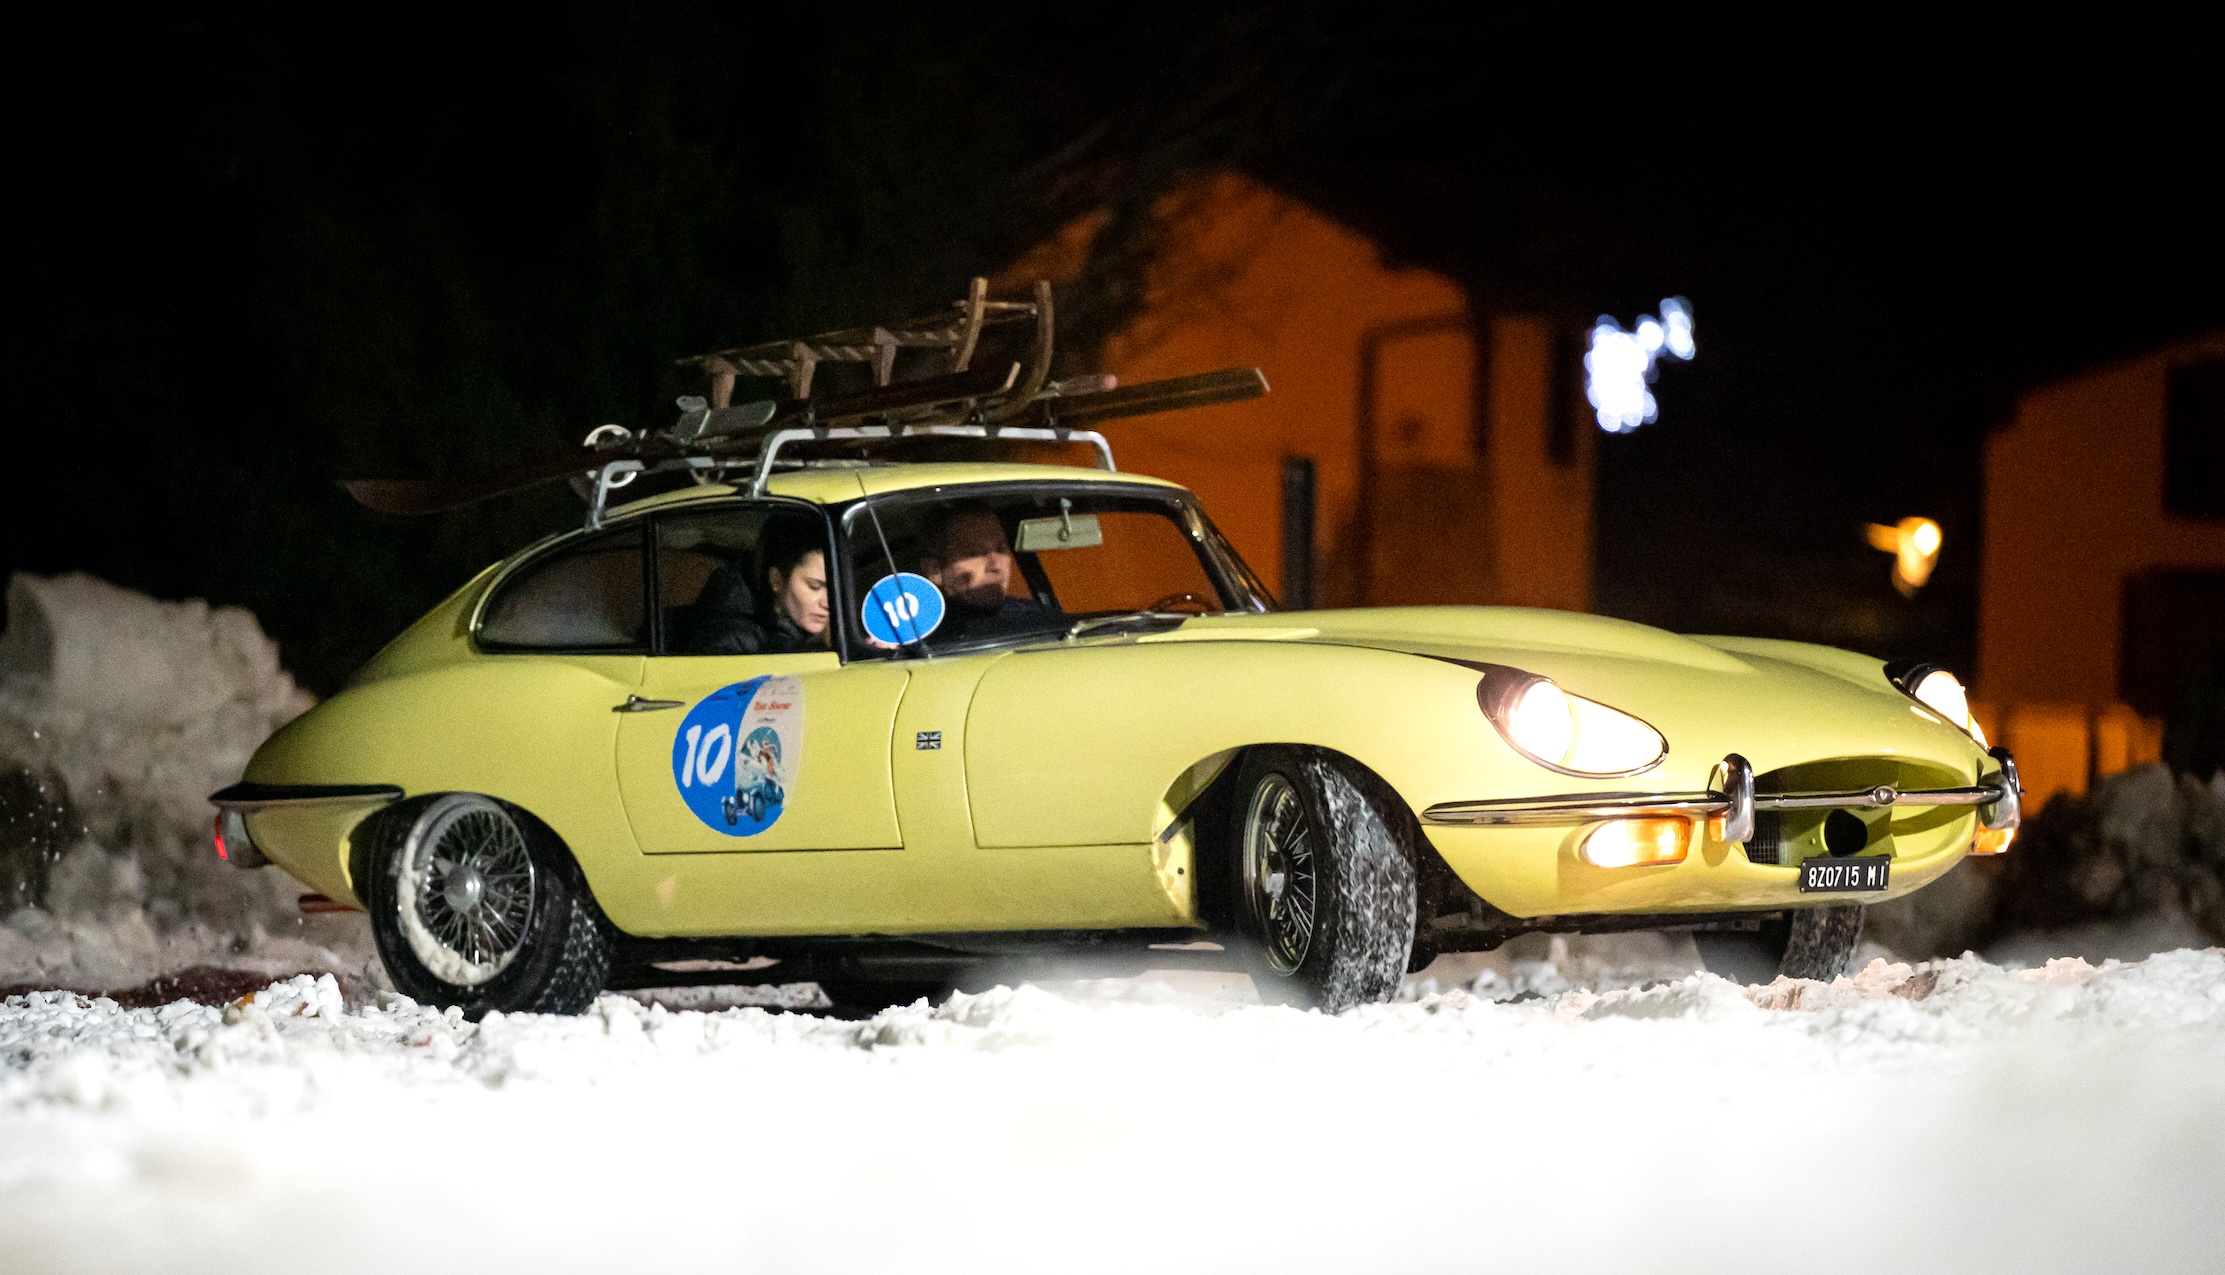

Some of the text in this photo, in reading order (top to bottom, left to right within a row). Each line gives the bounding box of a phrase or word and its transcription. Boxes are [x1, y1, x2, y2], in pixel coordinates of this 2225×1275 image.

[883, 592, 919, 628] 10
[682, 723, 732, 788] 10
[1808, 866, 1860, 888] 8Z0715
